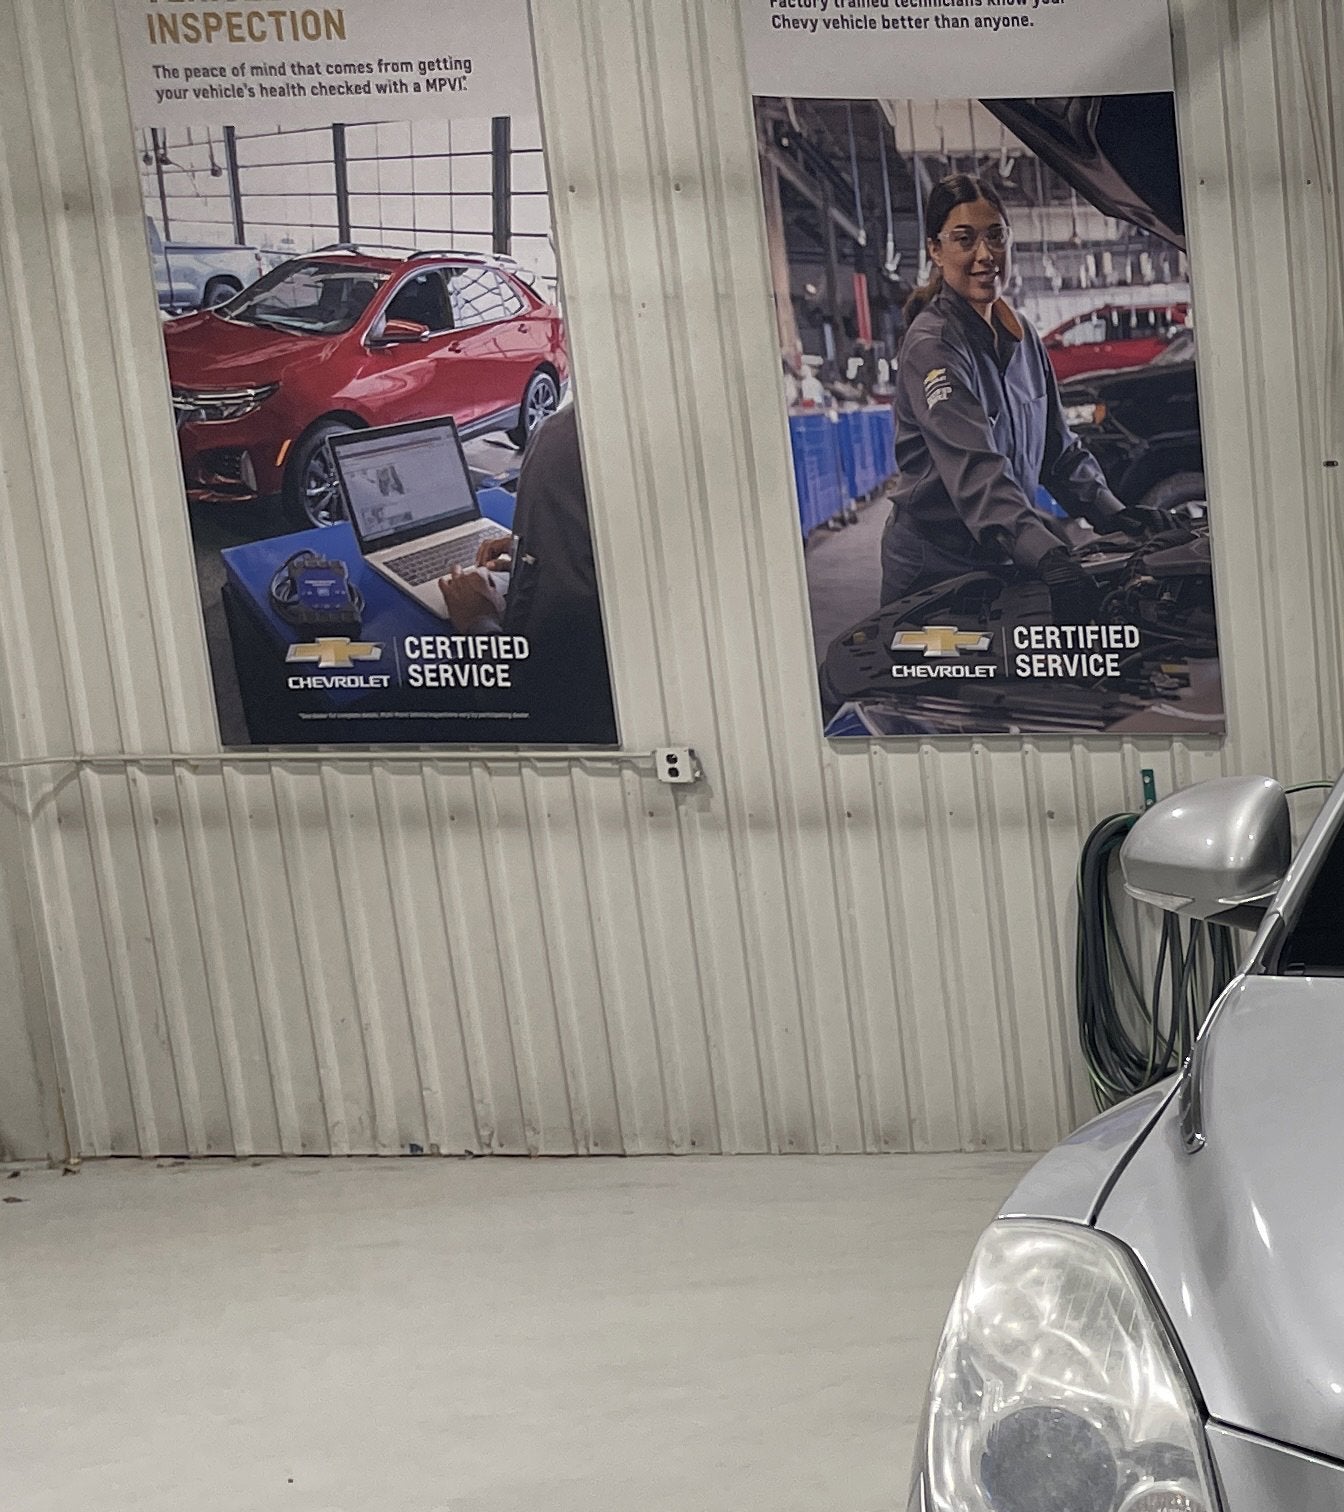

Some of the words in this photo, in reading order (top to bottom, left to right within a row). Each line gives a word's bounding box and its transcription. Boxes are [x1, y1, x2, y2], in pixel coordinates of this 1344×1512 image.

[147, 9, 347, 45] INSPECTION
[771, 14, 818, 33] Chevy
[823, 14, 877, 29] vehicle
[881, 14, 929, 29] better
[934, 14, 969, 28] than
[974, 15, 1034, 31] anyone.
[153, 65, 180, 79] The
[185, 65, 227, 82] peace
[231, 63, 246, 77] of
[250, 62, 287, 77] mind
[291, 62, 322, 76] that
[326, 62, 373, 75] comes
[378, 58, 413, 73] from
[418, 55, 472, 75] getting
[156, 86, 189, 103] your
[193, 84, 255, 99] vehicle's
[260, 82, 307, 97] health
[311, 80, 371, 96] checked
[376, 79, 408, 94] with
[413, 81, 421, 92] a
[404, 635, 530, 660] CERTIFIED
[1013, 625, 1140, 650] CERTIFIED
[408, 664, 512, 689] SERVICE
[892, 664, 997, 679] CHEVROLET
[1015, 653, 1121, 679] SERVICE
[288, 675, 390, 690] CHEVROLET
